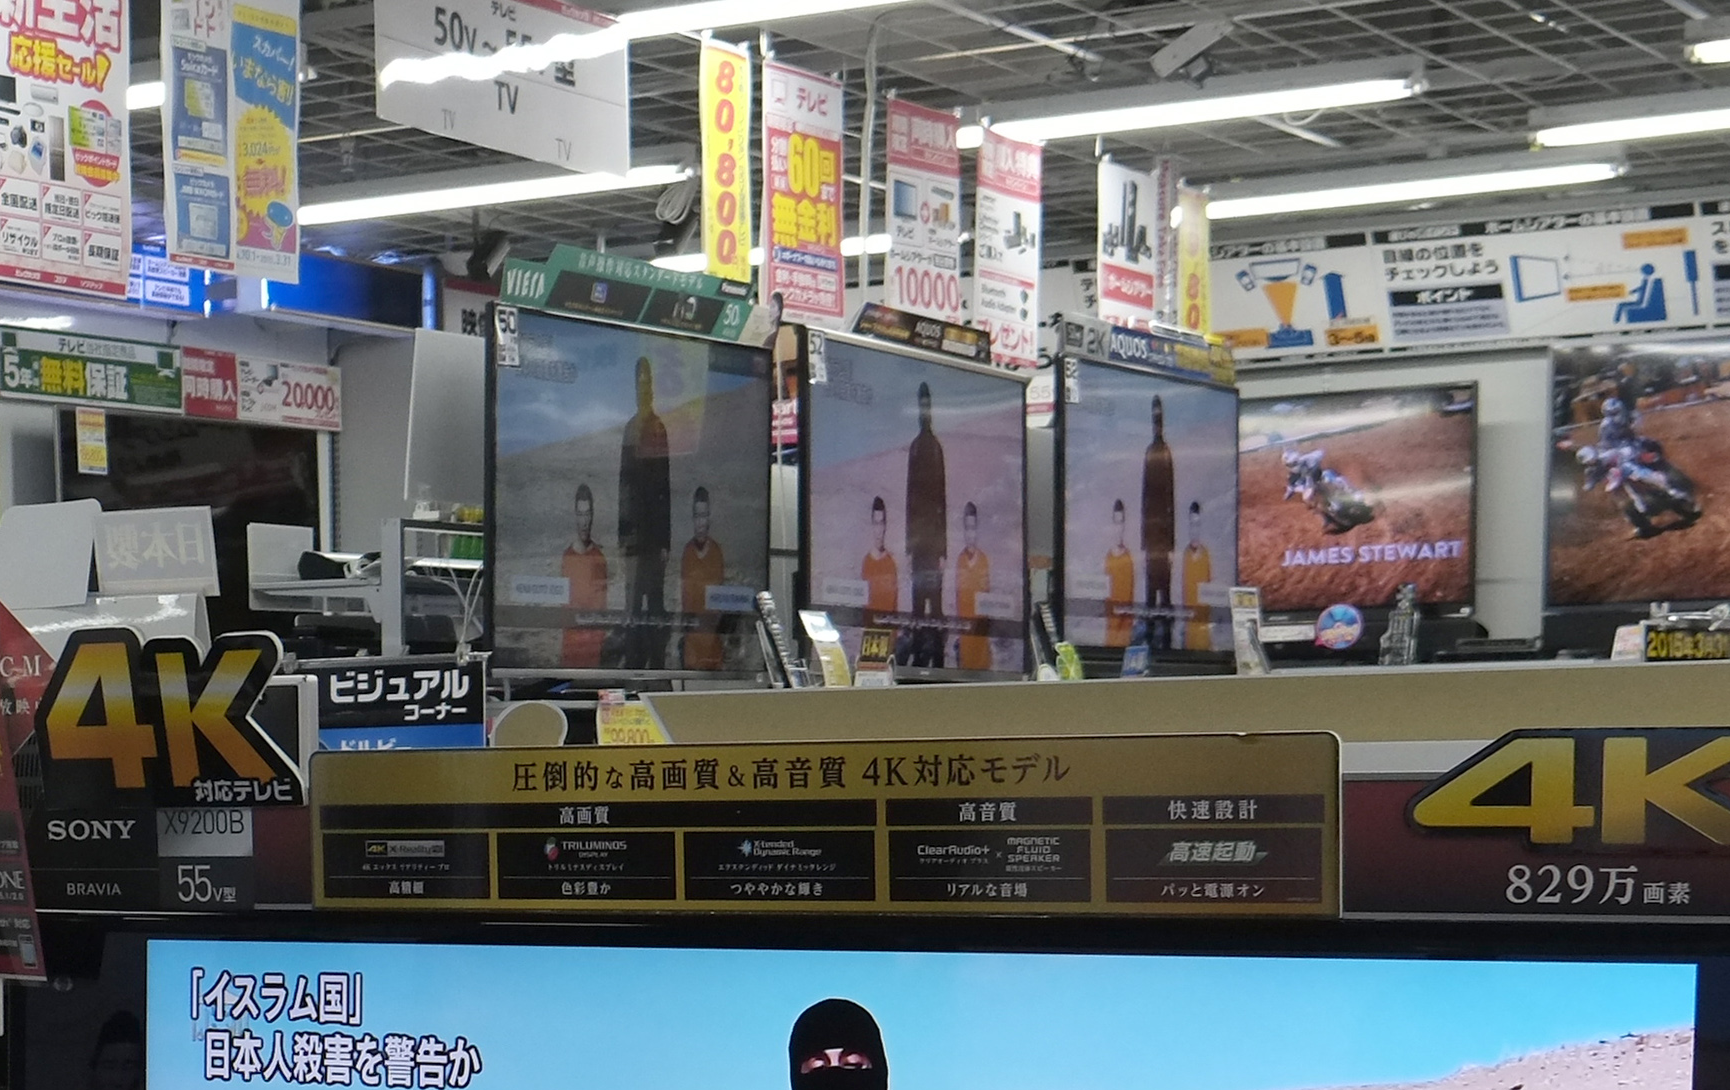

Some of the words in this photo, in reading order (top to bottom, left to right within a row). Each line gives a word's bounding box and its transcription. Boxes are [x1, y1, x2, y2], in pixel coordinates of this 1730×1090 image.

[490, 0, 517, 22] テレビ
[7, 30, 112, 93] 応援セール!
[493, 81, 519, 115] TV
[796, 87, 828, 117] テレビ
[772, 192, 837, 248] 無金利
[1, 231, 38, 248] リサイクル
[1384, 258, 1500, 282] チェックしよう
[1417, 288, 1474, 304] ポイント
[498, 308, 517, 334] 50
[58, 337, 86, 354] テレビ
[1086, 328, 1104, 356] 2K
[1110, 332, 1149, 360] AQUOS
[1281, 542, 1354, 568] JAMES
[1356, 539, 1464, 563] STEWART
[330, 669, 470, 704] ビジュアル
[46, 642, 278, 789] 4K
[403, 704, 468, 721] コーナー
[511, 758, 848, 795] 圧倒的な高画質&高音質
[861, 753, 1071, 790] 4K対応モデル
[193, 777, 294, 804] 対応テレビ
[1412, 736, 1730, 846] 4K
[559, 805, 610, 825] 高画質
[958, 802, 1017, 823] 高音質
[1168, 798, 1259, 822] 快速設計
[47, 819, 137, 842] SONY
[164, 808, 245, 837] X9200B
[367, 843, 386, 855] 4K
[561, 840, 628, 851] TRILUMINOS
[753, 839, 795, 850] X-tended
[791, 847, 822, 857] Range
[917, 845, 991, 857] ClearAudio+
[1006, 837, 1061, 846] MAGNETIC
[1016, 845, 1051, 855] FLUID
[1168, 841, 1257, 864] 高速起動
[1007, 854, 1061, 863] SPEAKER
[66, 881, 122, 897] BRAVIA
[176, 863, 237, 905] 55V型
[388, 881, 425, 895] 高精細
[561, 881, 612, 895] 色彩豊か
[730, 881, 824, 897] つややかな輝き
[946, 882, 1029, 898] リアルな音場
[1160, 880, 1266, 901] パッと電源オン
[1505, 864, 1692, 907] 829万画素
[191, 967, 363, 1027] 「イスラム国」
[205, 1029, 483, 1089] 日本人殺害を警告か
